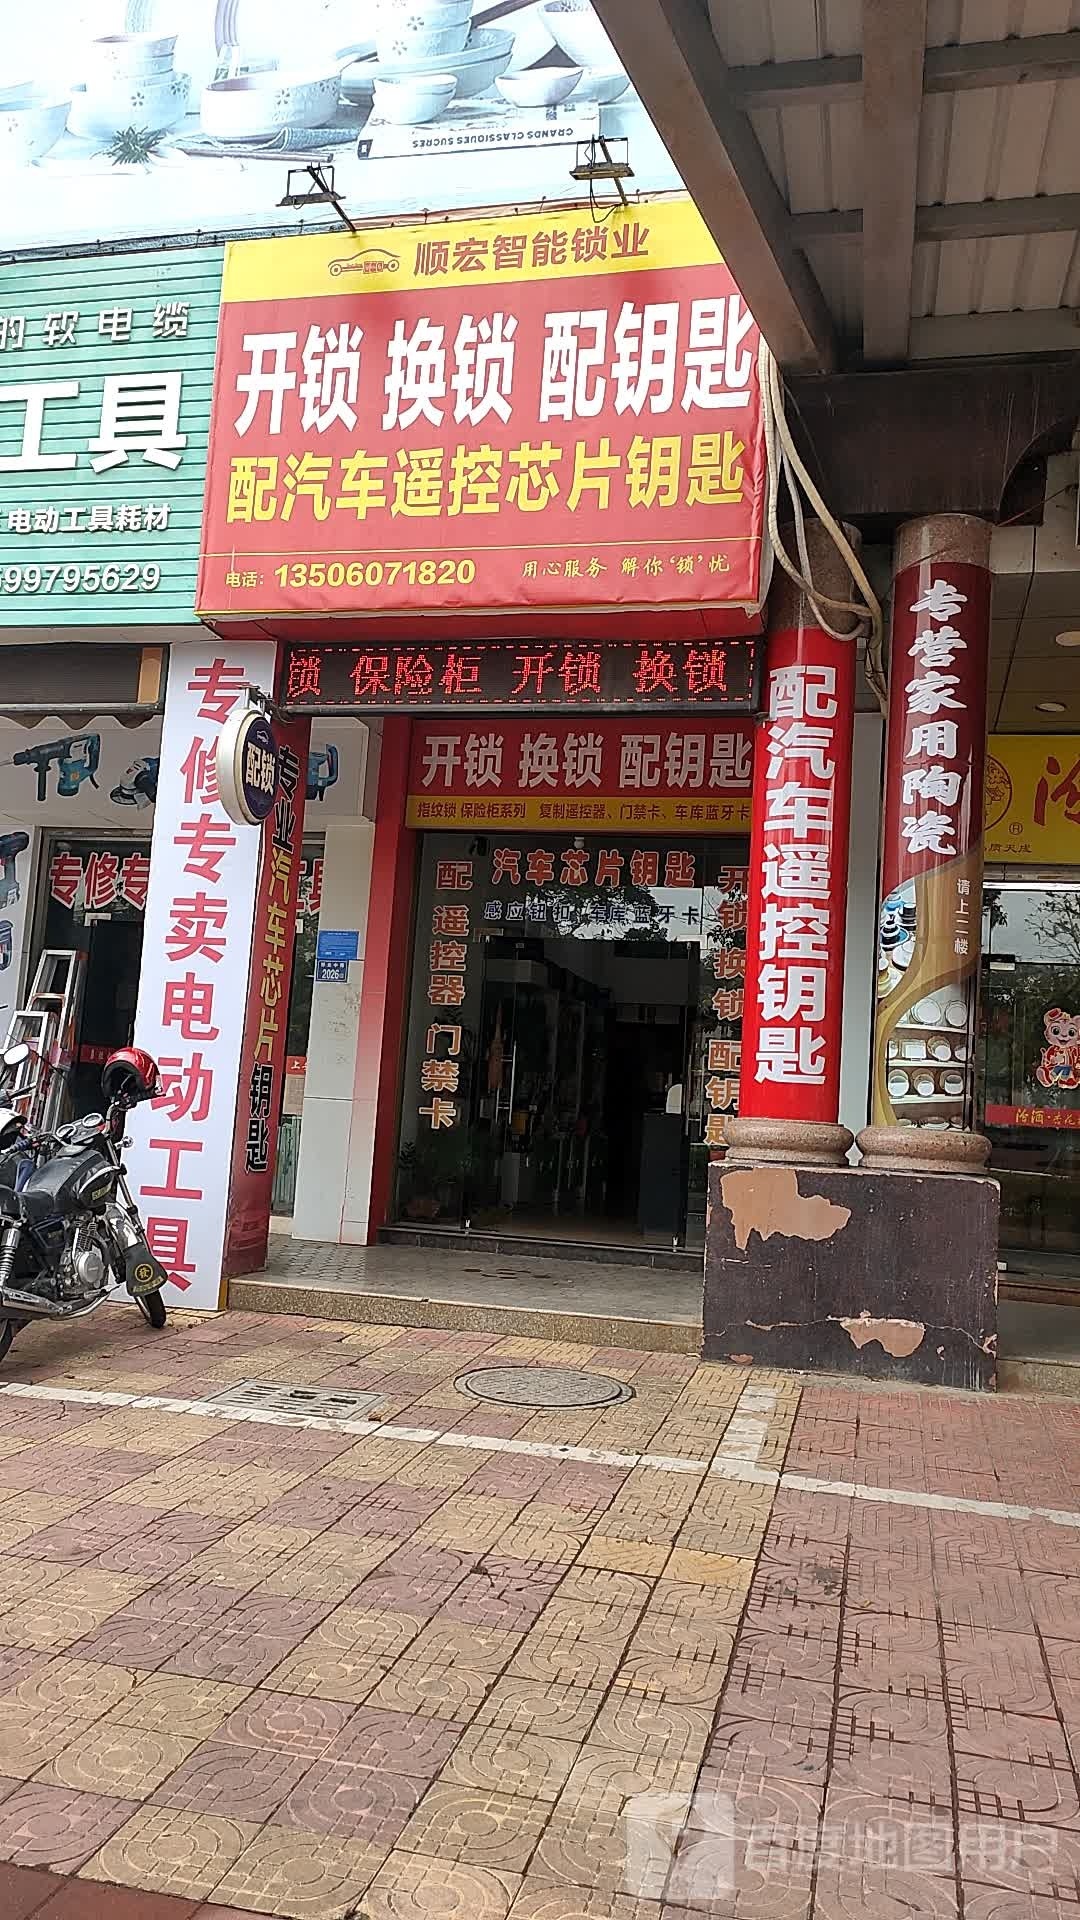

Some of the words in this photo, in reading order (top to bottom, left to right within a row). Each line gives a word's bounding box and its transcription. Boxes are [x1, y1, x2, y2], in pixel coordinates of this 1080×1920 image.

[413, 222, 650, 277] 顺宏智能锁业
[0, 301, 190, 349] 的软电缆
[234, 322, 364, 437] 开锁
[382, 312, 516, 431] 换锁
[538, 293, 754, 424] 配钥匙
[0, 371, 188, 473] 工具
[226, 431, 747, 524] 配汽车遥控芯片钥匙
[8, 503, 171, 533] 电动工具耗材
[0, 563, 161, 593] 99795629
[273, 558, 477, 589] 13506071820
[521, 559, 608, 580] 用心服务
[349, 654, 483, 698] 保险柜
[512, 651, 601, 695] 开锁
[632, 648, 727, 696] 换锁
[902, 579, 968, 855] 专营家用陶瓷
[245, 741, 276, 796] 配锁
[422, 734, 504, 788] 开锁
[518, 733, 603, 788] 换锁
[619, 731, 753, 788] 配钥匙
[436, 860, 473, 890] 配
[492, 849, 696, 888] 汽车芯片钥匙
[718, 865, 750, 931] 开锁
[753, 664, 837, 1085] 配汽车遥控钥匙
[953, 878, 971, 956] 请上二楼
[140, 657, 246, 1291] 专修专卖电动工具
[429, 904, 470, 1006] 遥控器
[712, 946, 747, 1021] 换锁
[418, 1022, 463, 1130] 门禁卡
